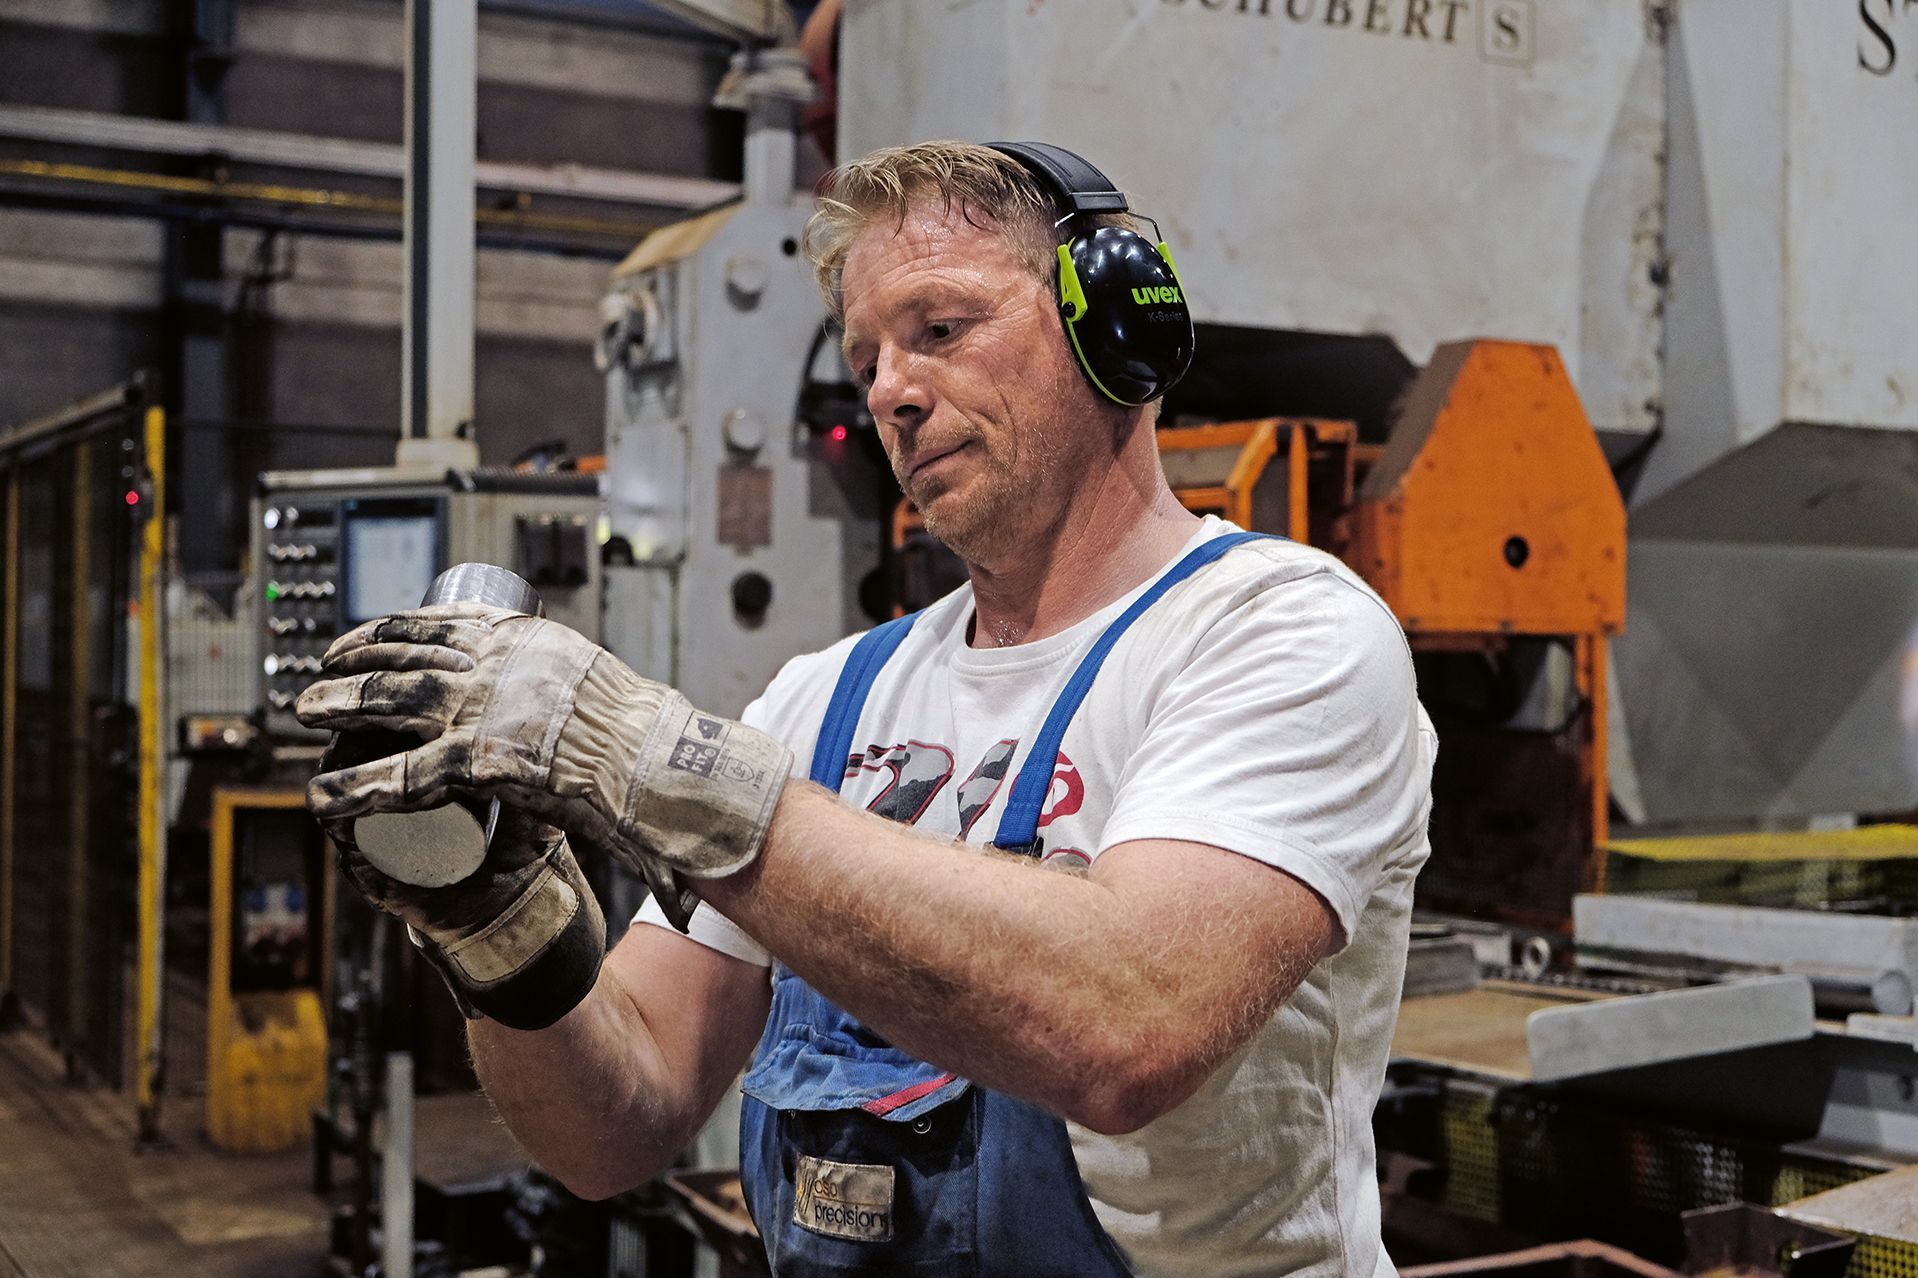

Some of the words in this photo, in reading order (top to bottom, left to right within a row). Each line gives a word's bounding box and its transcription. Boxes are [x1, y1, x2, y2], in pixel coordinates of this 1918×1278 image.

[1131, 286, 1184, 304] uvex
[677, 744, 696, 768] PRO
[815, 1205, 884, 1228] precision
